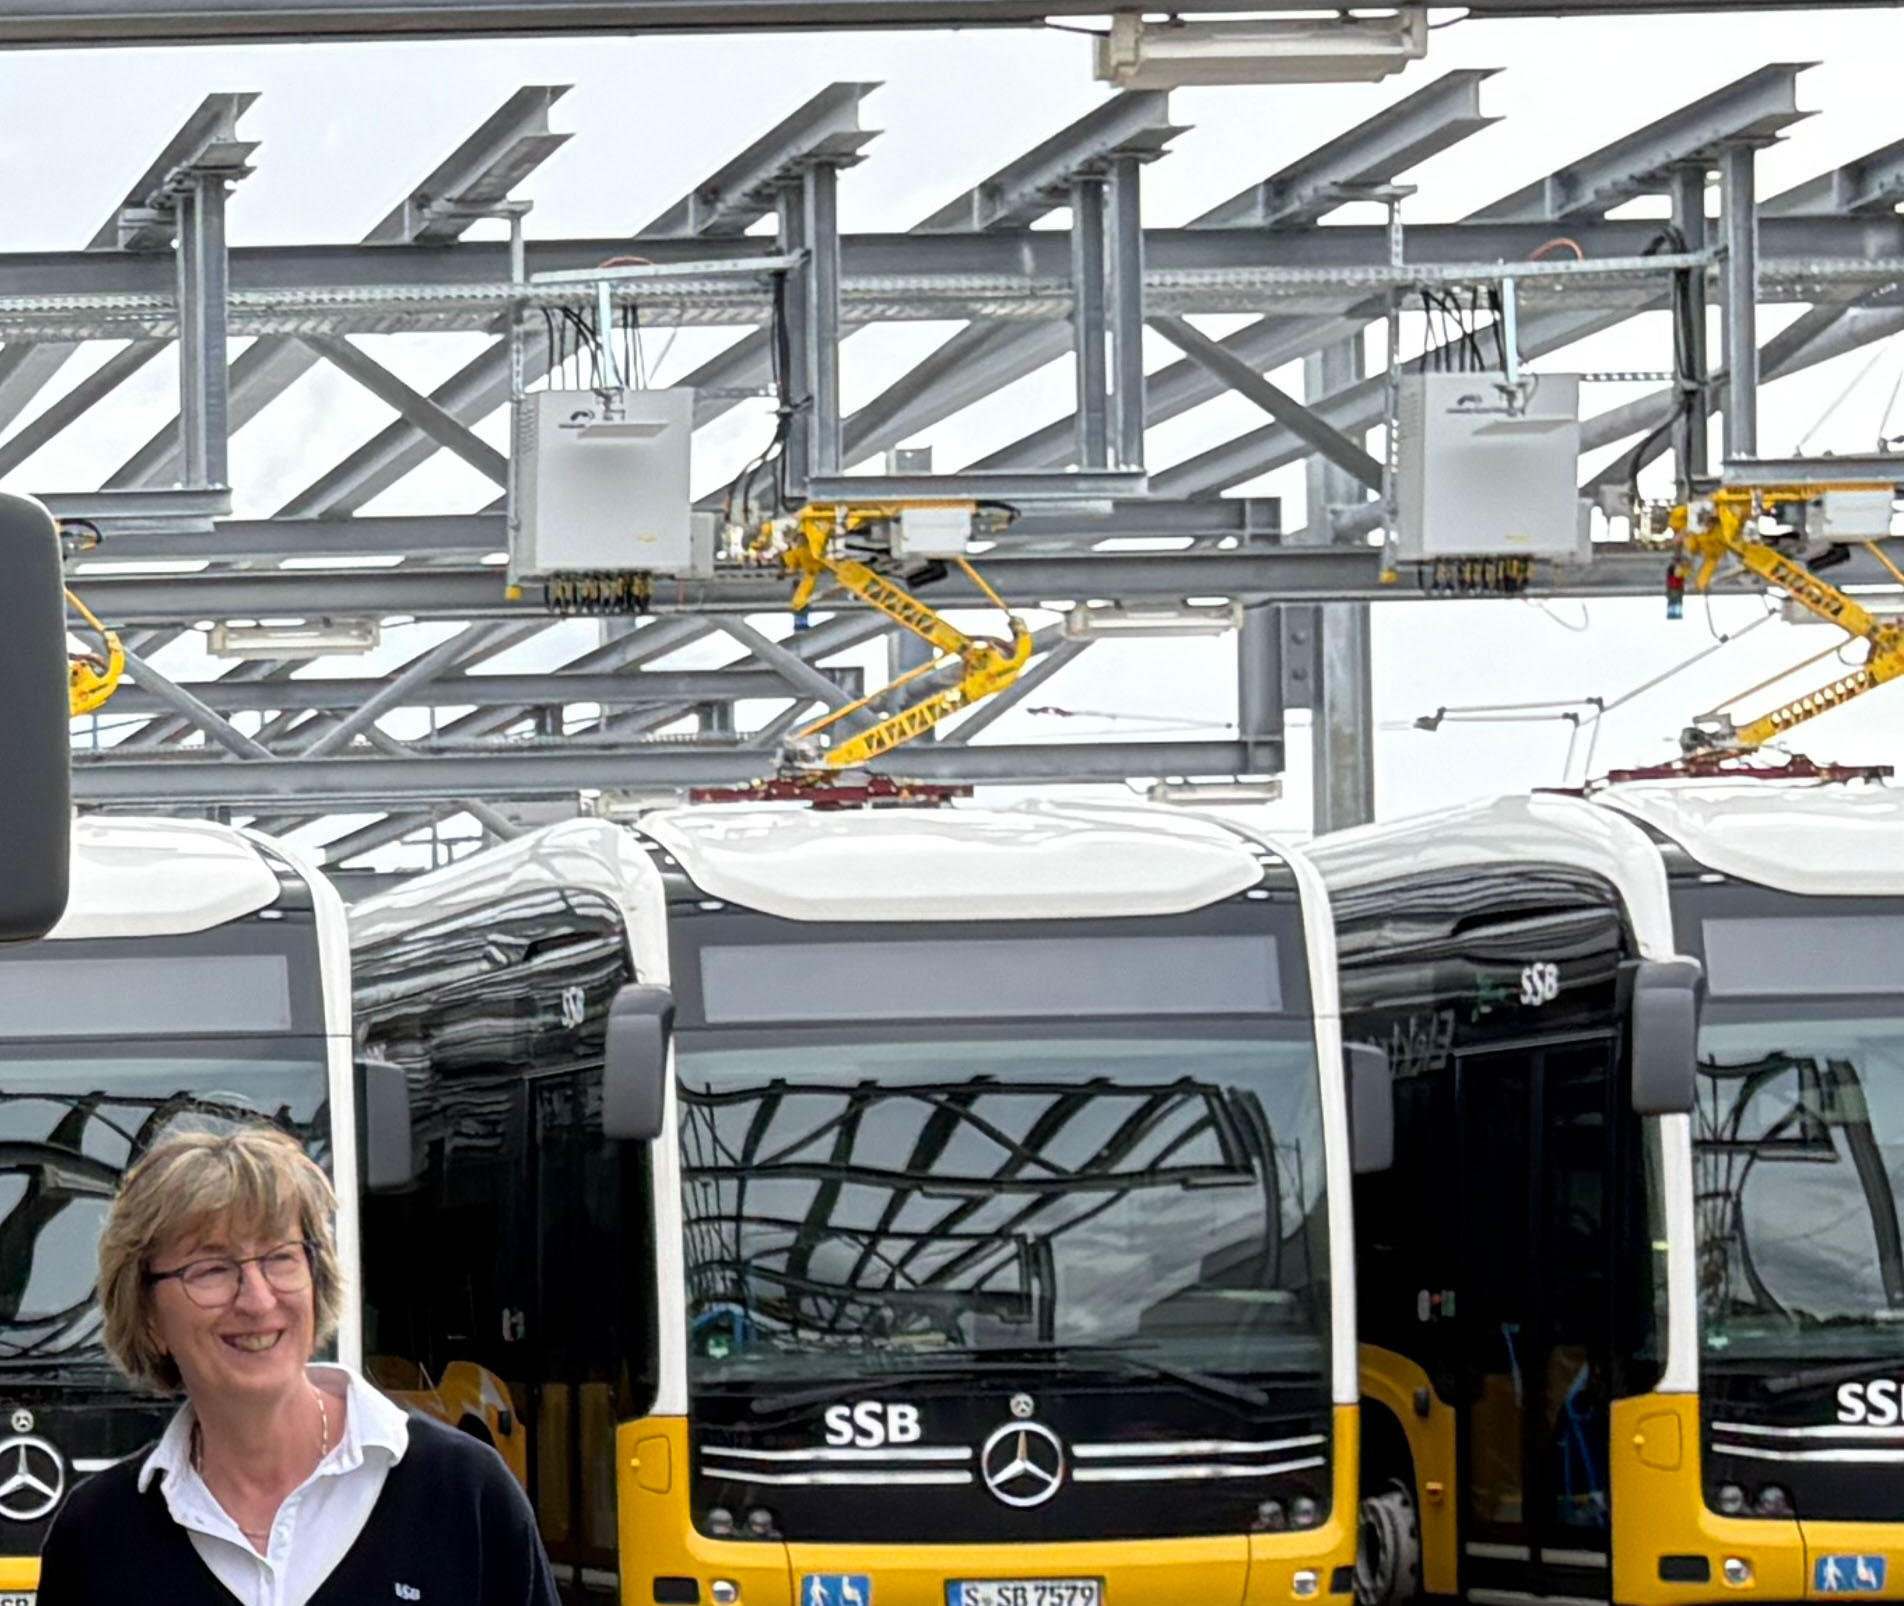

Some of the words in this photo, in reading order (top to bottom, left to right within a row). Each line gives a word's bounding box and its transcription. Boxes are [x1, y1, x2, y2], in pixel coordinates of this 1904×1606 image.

[1519, 962, 1560, 1006] SSB
[824, 1400, 922, 1449] SSB
[1836, 1378, 1904, 1426] SS
